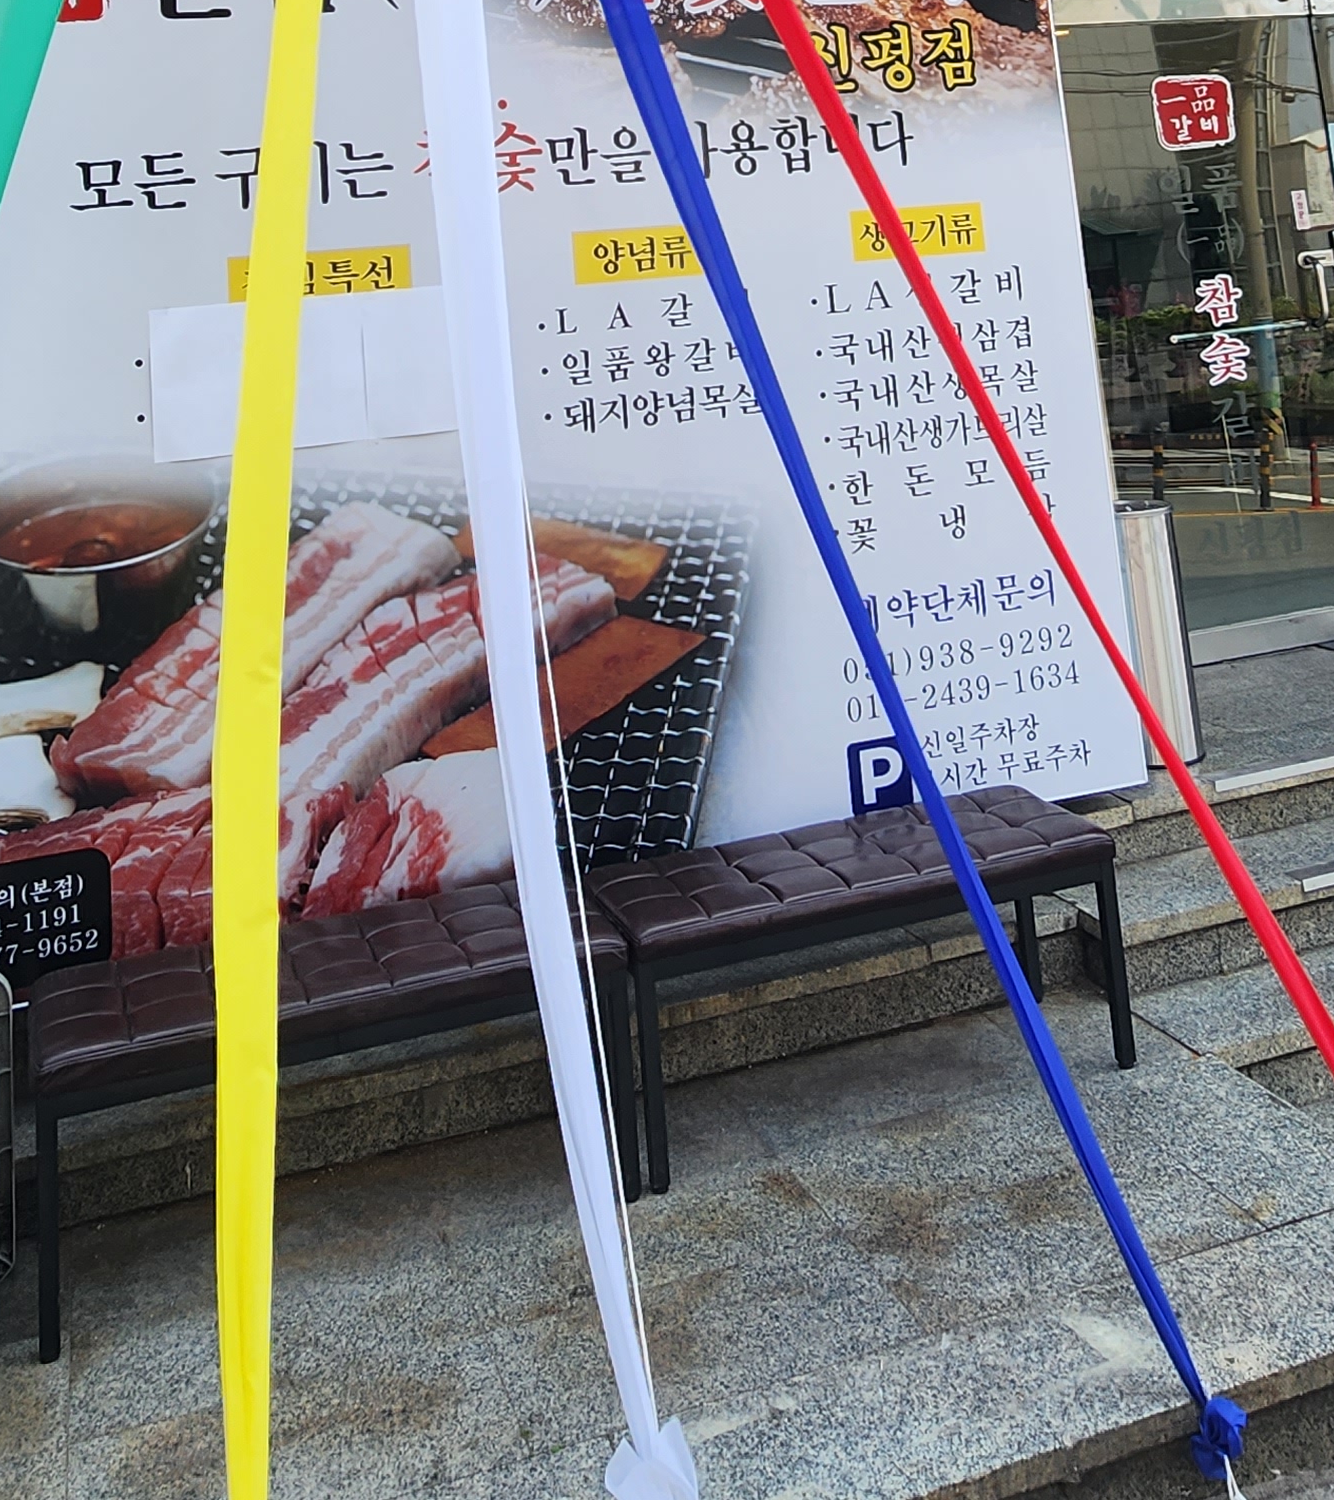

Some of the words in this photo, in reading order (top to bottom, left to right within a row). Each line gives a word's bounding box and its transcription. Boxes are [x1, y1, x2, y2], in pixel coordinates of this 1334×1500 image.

[813, 22, 976, 93] 신평점
[1170, 113, 1220, 143] 갈비
[70, 150, 197, 212] 모든
[414, 121, 651, 194] 숯만을
[240, 255, 398, 293] 특선
[592, 234, 693, 275] 양념류
[563, 381, 765, 435] 돼지양념목살
[843, 622, 1073, 686] 01)938-9292
[845, 659, 1081, 723] 01-2439-1634
[922, 713, 1041, 760] 신일주차장
[929, 757, 988, 791] 시간
[996, 740, 1093, 781] 무료주차
